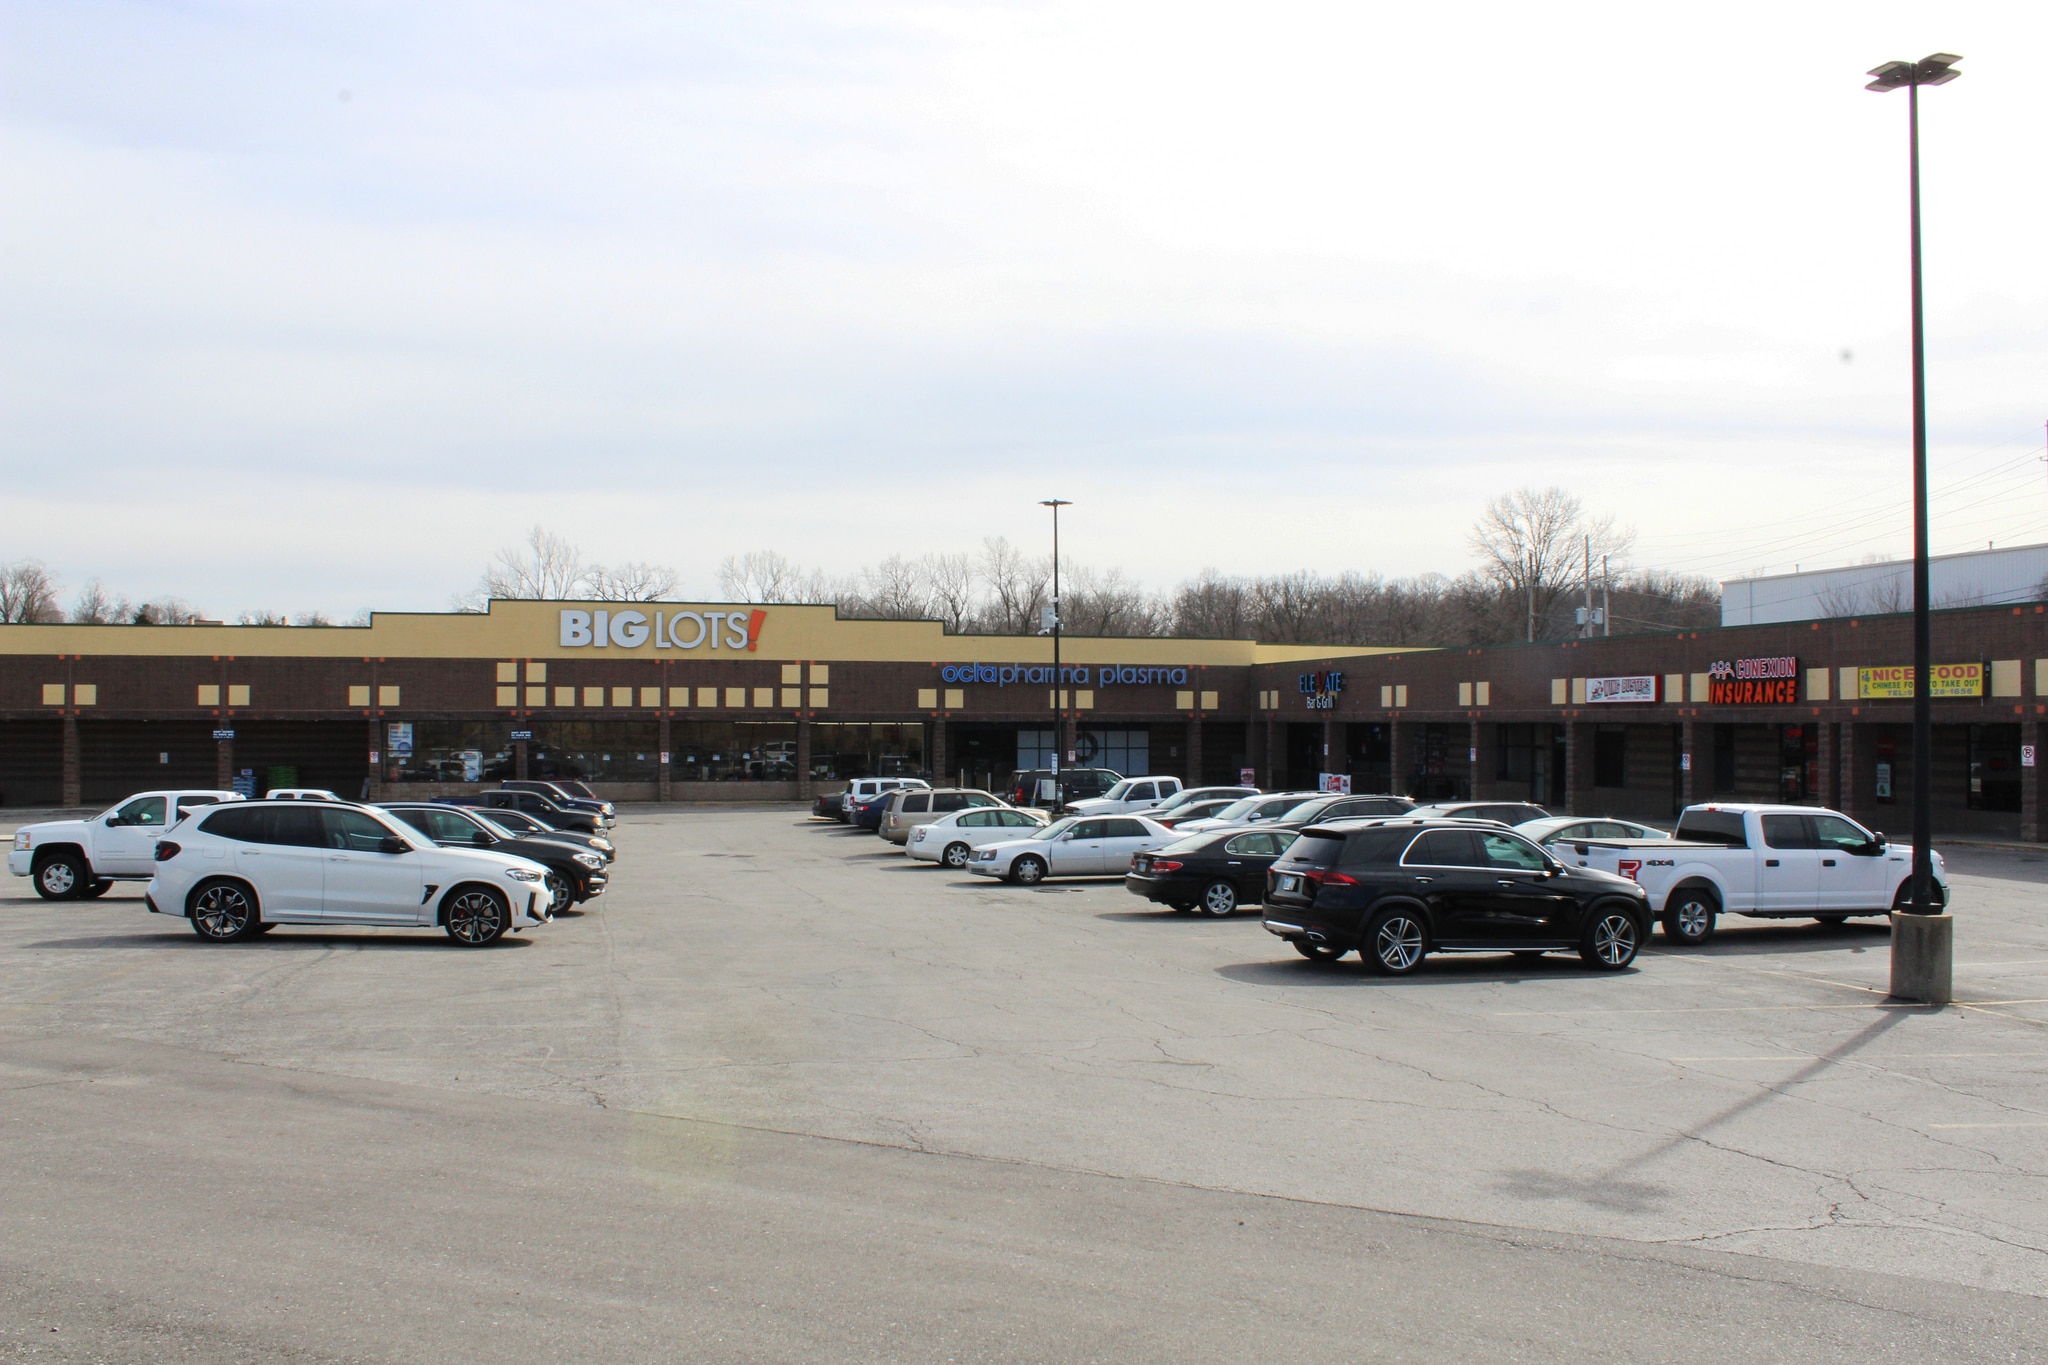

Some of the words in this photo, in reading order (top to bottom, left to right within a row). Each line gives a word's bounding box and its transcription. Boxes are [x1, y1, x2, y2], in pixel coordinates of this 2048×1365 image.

[560, 610, 650, 648] BIG
[656, 609, 767, 652] LOTS!
[942, 662, 1089, 687] octapharma
[1100, 664, 1187, 688] plasma
[1736, 657, 1795, 679] CONEXION
[1872, 668, 1914, 681] NICE
[1300, 671, 1341, 694] ELEVATE
[1708, 681, 1796, 704] INSURANCE
[1872, 681, 1900, 689] CHINESE
[1941, 680, 1961, 688] TAKE
[1306, 697, 1316, 709] Bar
[1322, 695, 1334, 708] Grill
